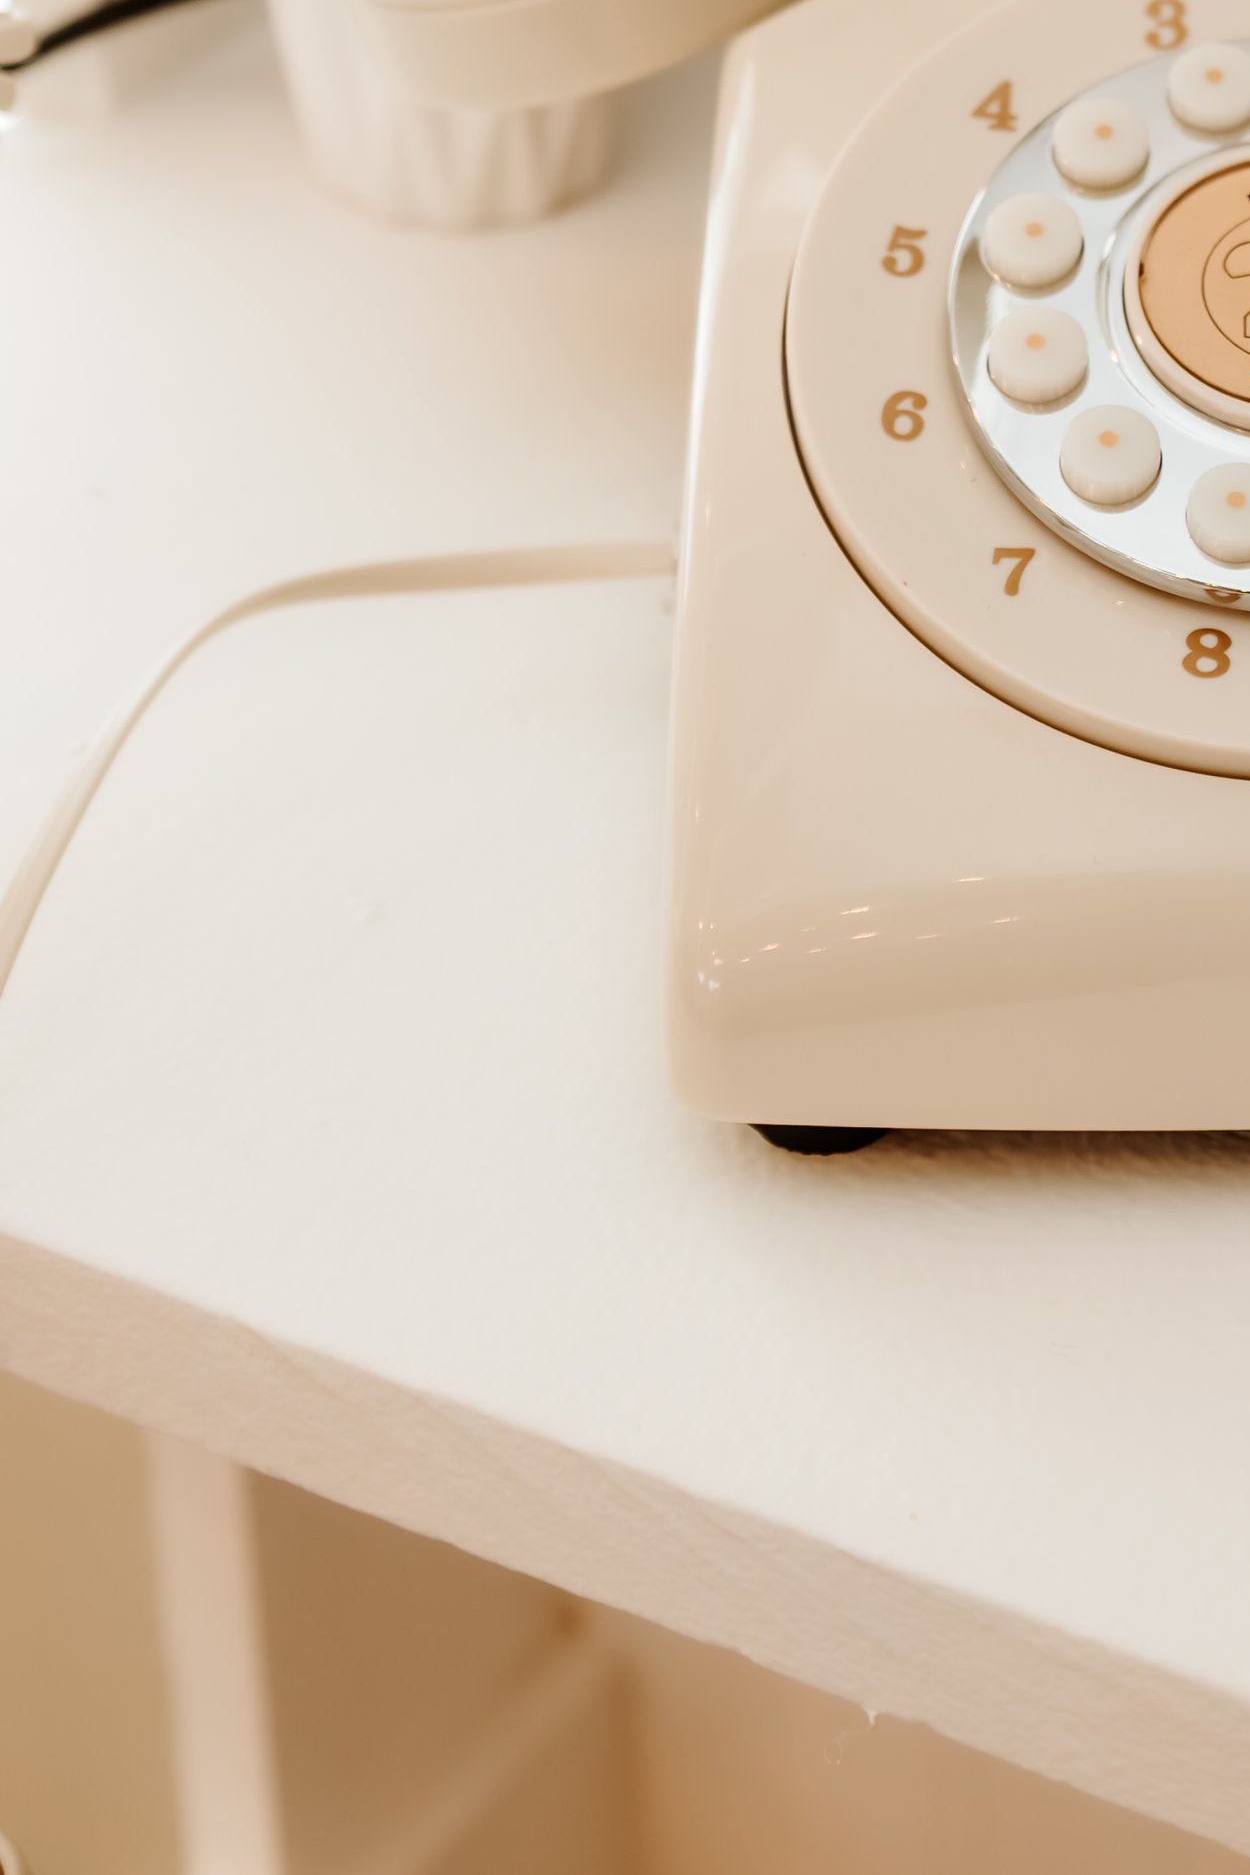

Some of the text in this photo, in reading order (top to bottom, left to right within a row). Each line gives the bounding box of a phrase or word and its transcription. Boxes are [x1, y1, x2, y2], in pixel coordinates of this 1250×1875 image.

[971, 80, 1018, 132] 4
[881, 224, 928, 278] 5
[881, 390, 928, 442] 6
[991, 548, 1036, 596] 7
[1182, 628, 1232, 678] 8
